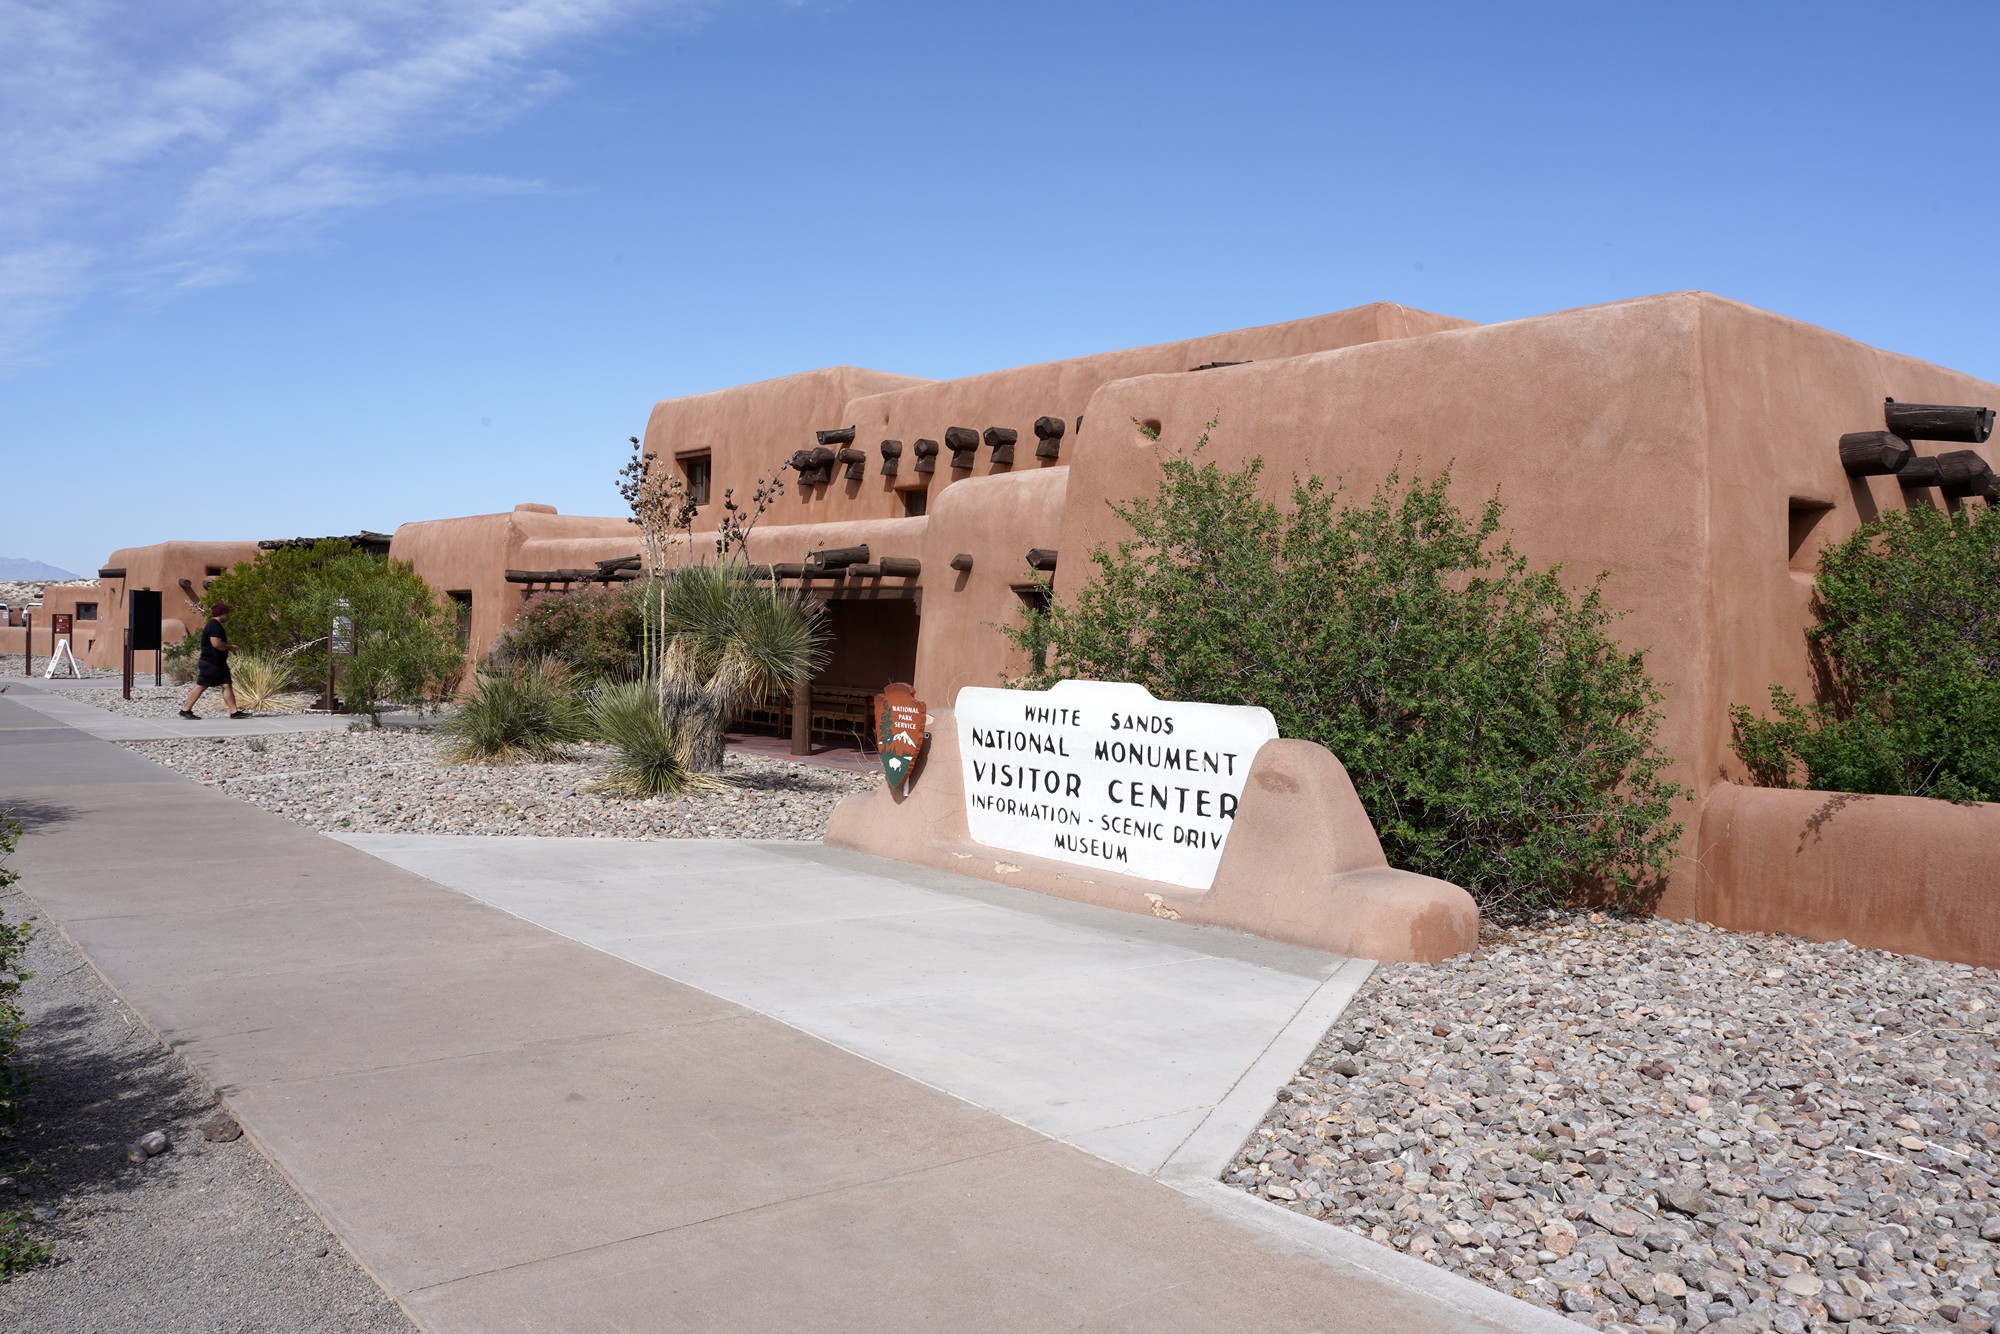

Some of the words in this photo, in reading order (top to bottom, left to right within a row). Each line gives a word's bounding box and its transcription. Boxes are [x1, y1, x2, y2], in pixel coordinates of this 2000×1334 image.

[892, 705, 919, 714] NATIONAL
[898, 714, 912, 722] PARK
[1025, 705, 1081, 727] WHITE
[1110, 712, 1174, 736] SANDS
[894, 721, 917, 730] SERVICE
[972, 727, 1070, 758] NATIONAL
[1094, 740, 1238, 777] MONUMENT
[973, 759, 1083, 799] VISITOR
[1108, 779, 1239, 821] CENTER
[972, 794, 1081, 826] INFORMATION
[1101, 814, 1164, 841] SCENIC
[1053, 833, 1128, 863] MUSEUM
